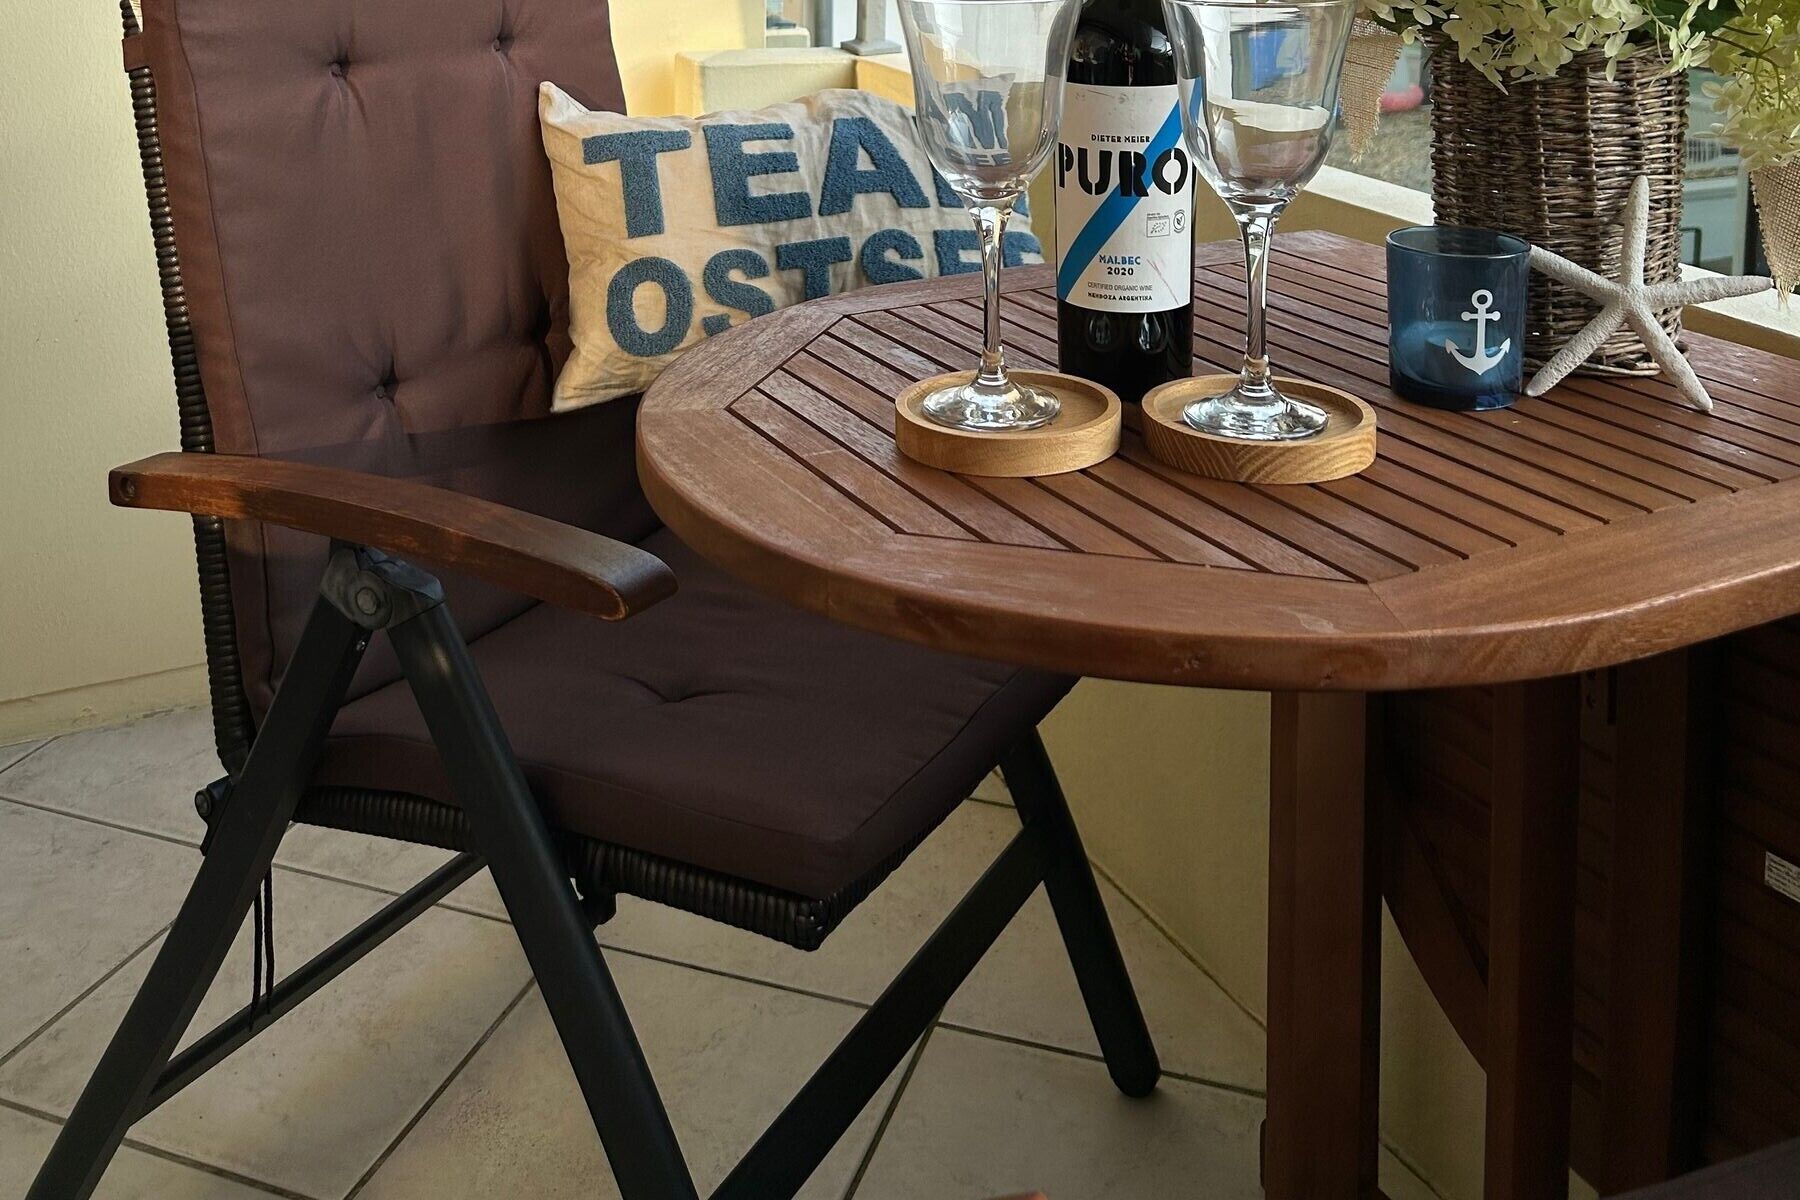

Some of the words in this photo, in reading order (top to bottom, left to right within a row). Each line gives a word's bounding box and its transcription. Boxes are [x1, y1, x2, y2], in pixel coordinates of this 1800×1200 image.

[1091, 134, 1122, 143] DIETER
[1124, 135, 1151, 143] MEIER
[1058, 142, 1189, 197] PURO
[1099, 254, 1141, 265] MALBEC
[1106, 266, 1134, 276] 2020
[1087, 281, 1113, 291] CERTIFIED
[1113, 284, 1138, 292] ORGANIC
[1087, 291, 1117, 301] MENDOZA
